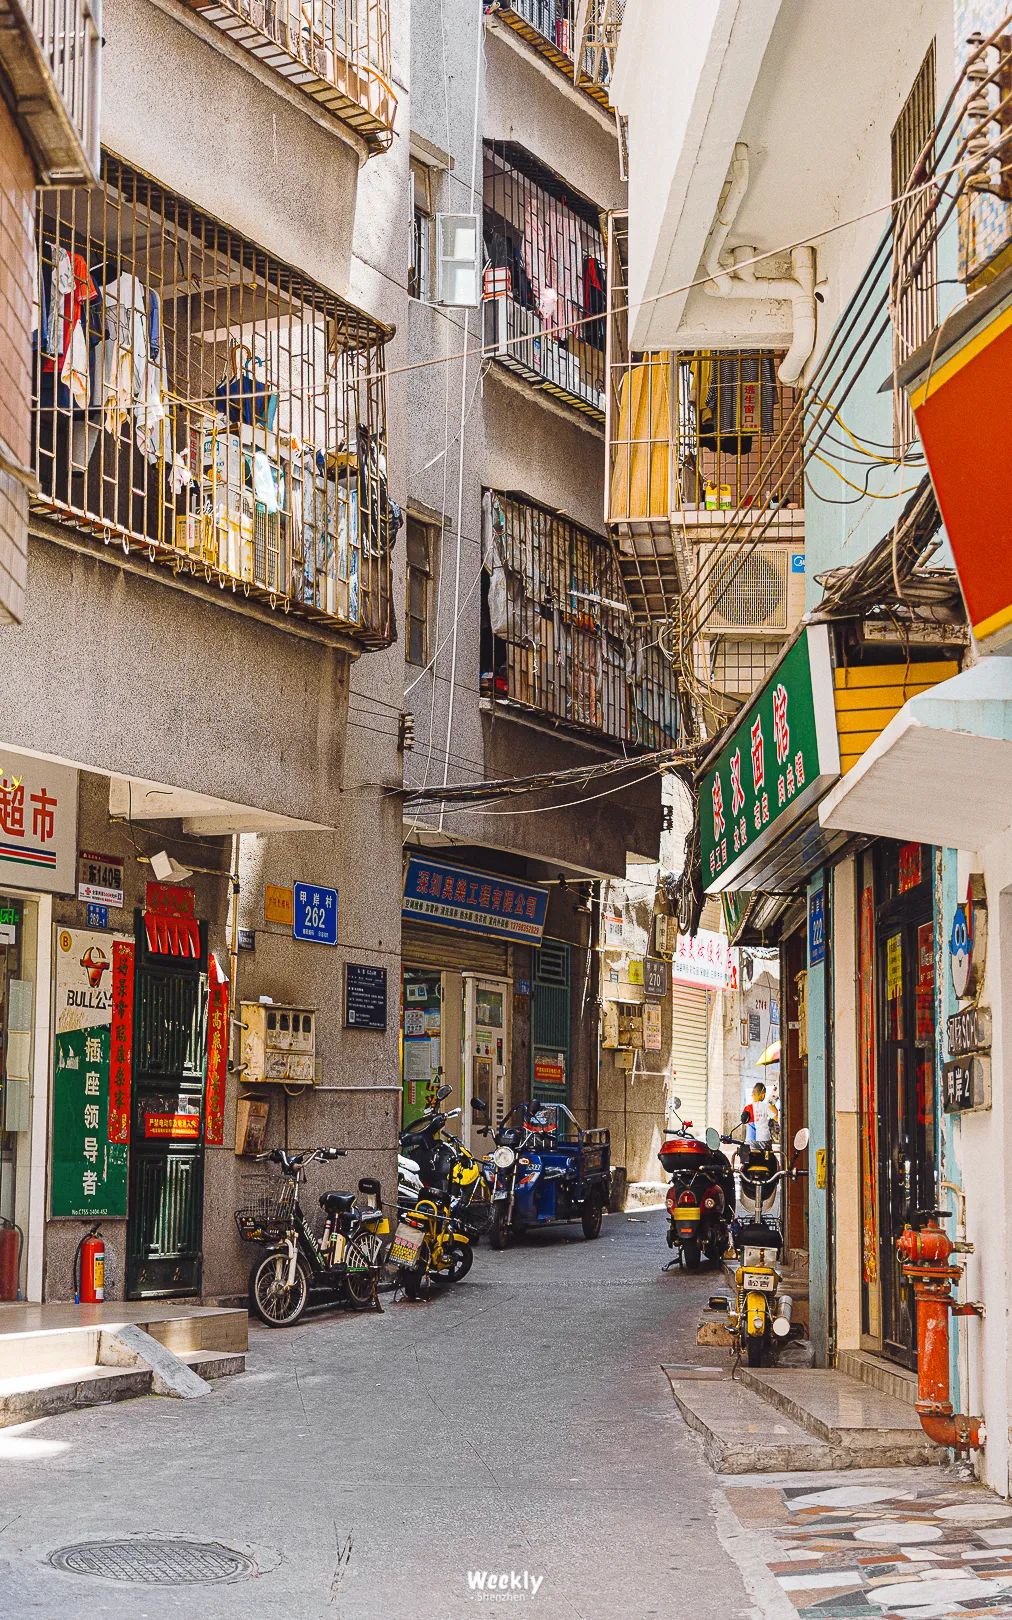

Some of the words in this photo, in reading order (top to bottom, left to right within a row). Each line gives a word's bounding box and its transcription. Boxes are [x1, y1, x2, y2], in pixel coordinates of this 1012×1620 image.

[744, 384, 756, 423] 逃生窗口
[0, 779, 58, 843] 超市
[299, 891, 333, 909] 甲岸村
[304, 906, 326, 928] 262
[812, 919, 823, 945] 222
[649, 973, 661, 987] 270
[82, 1038, 102, 1196] 插座领导者
[301, 1217, 319, 1252] YAMAHA
